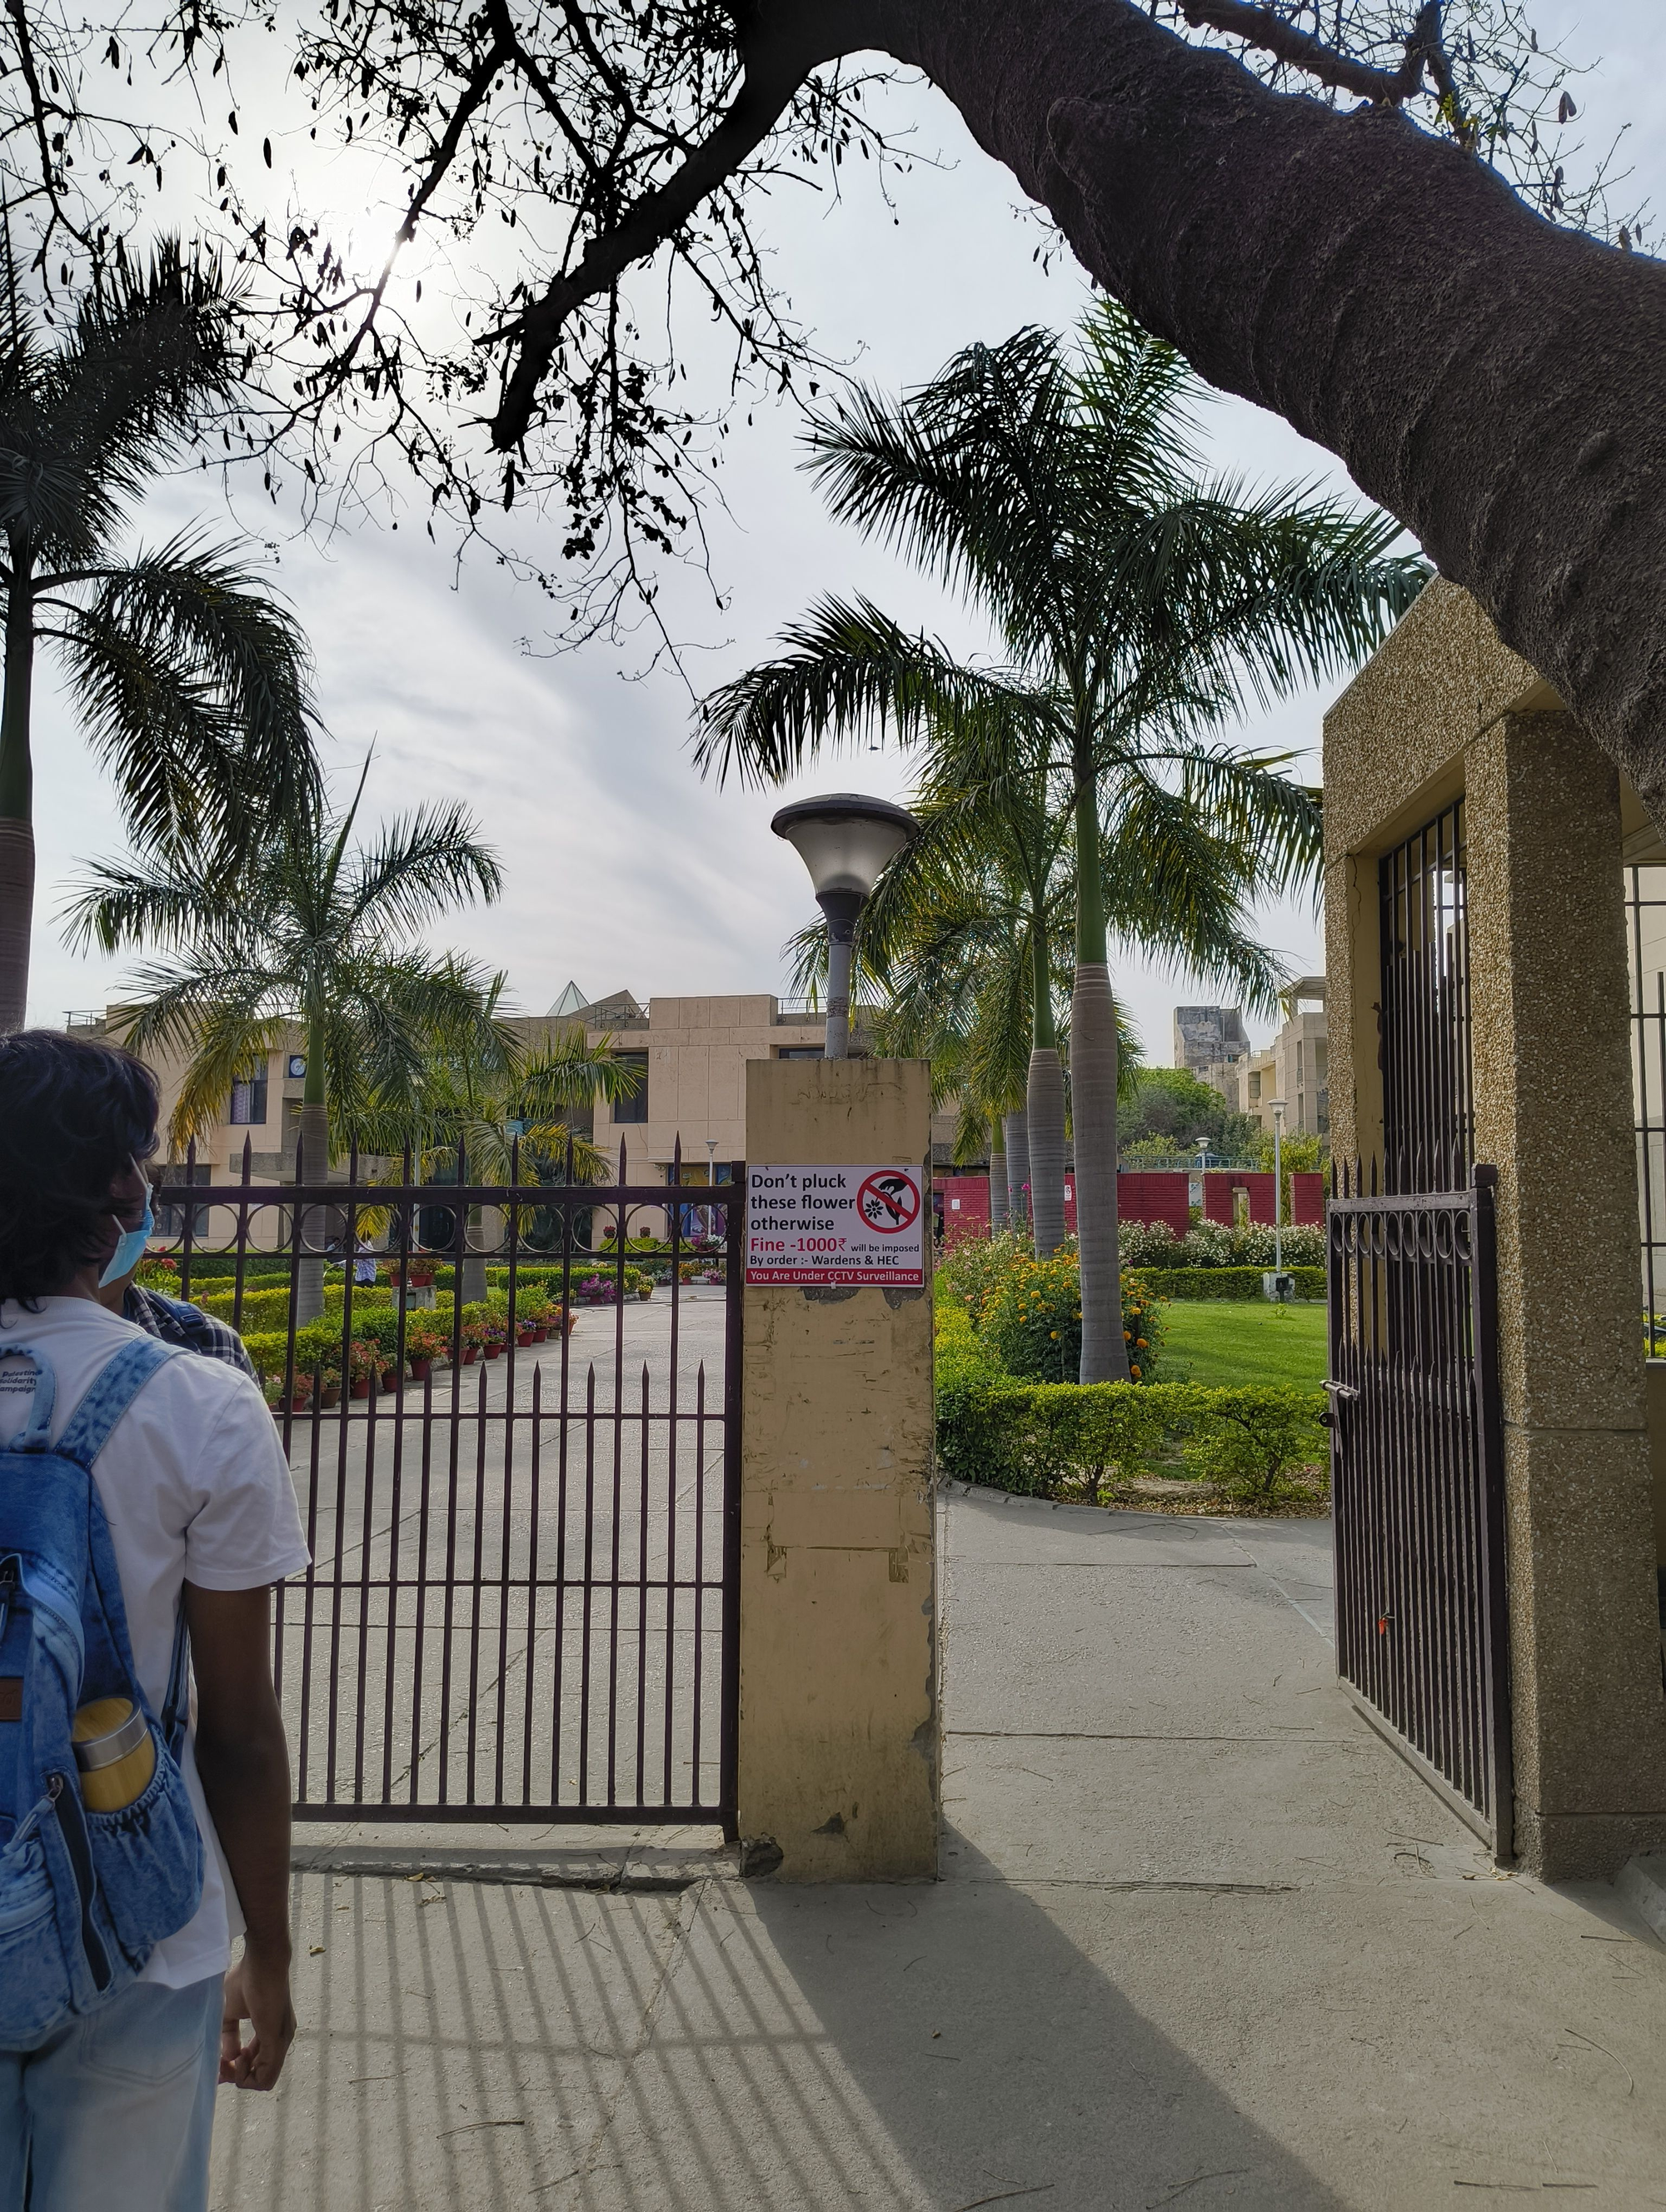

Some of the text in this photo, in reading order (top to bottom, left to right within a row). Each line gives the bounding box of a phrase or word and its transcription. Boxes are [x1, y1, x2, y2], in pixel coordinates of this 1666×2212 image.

[802, 1173, 846, 1191] pluck
[751, 1194, 855, 1209] these flower
[751, 1216, 835, 1231] otherwise
[751, 1238, 785, 1252] Fine
[850, 1243, 866, 1252] will
[882, 1244, 920, 1253] imposed
[750, 1255, 764, 1267] By
[766, 1255, 797, 1265] order
[811, 1255, 861, 1265] Wardens
[865, 1255, 874, 1265] &
[877, 1255, 900, 1265] HEC
[751, 1271, 919, 1281] You Are Under CCTV Surveillance
